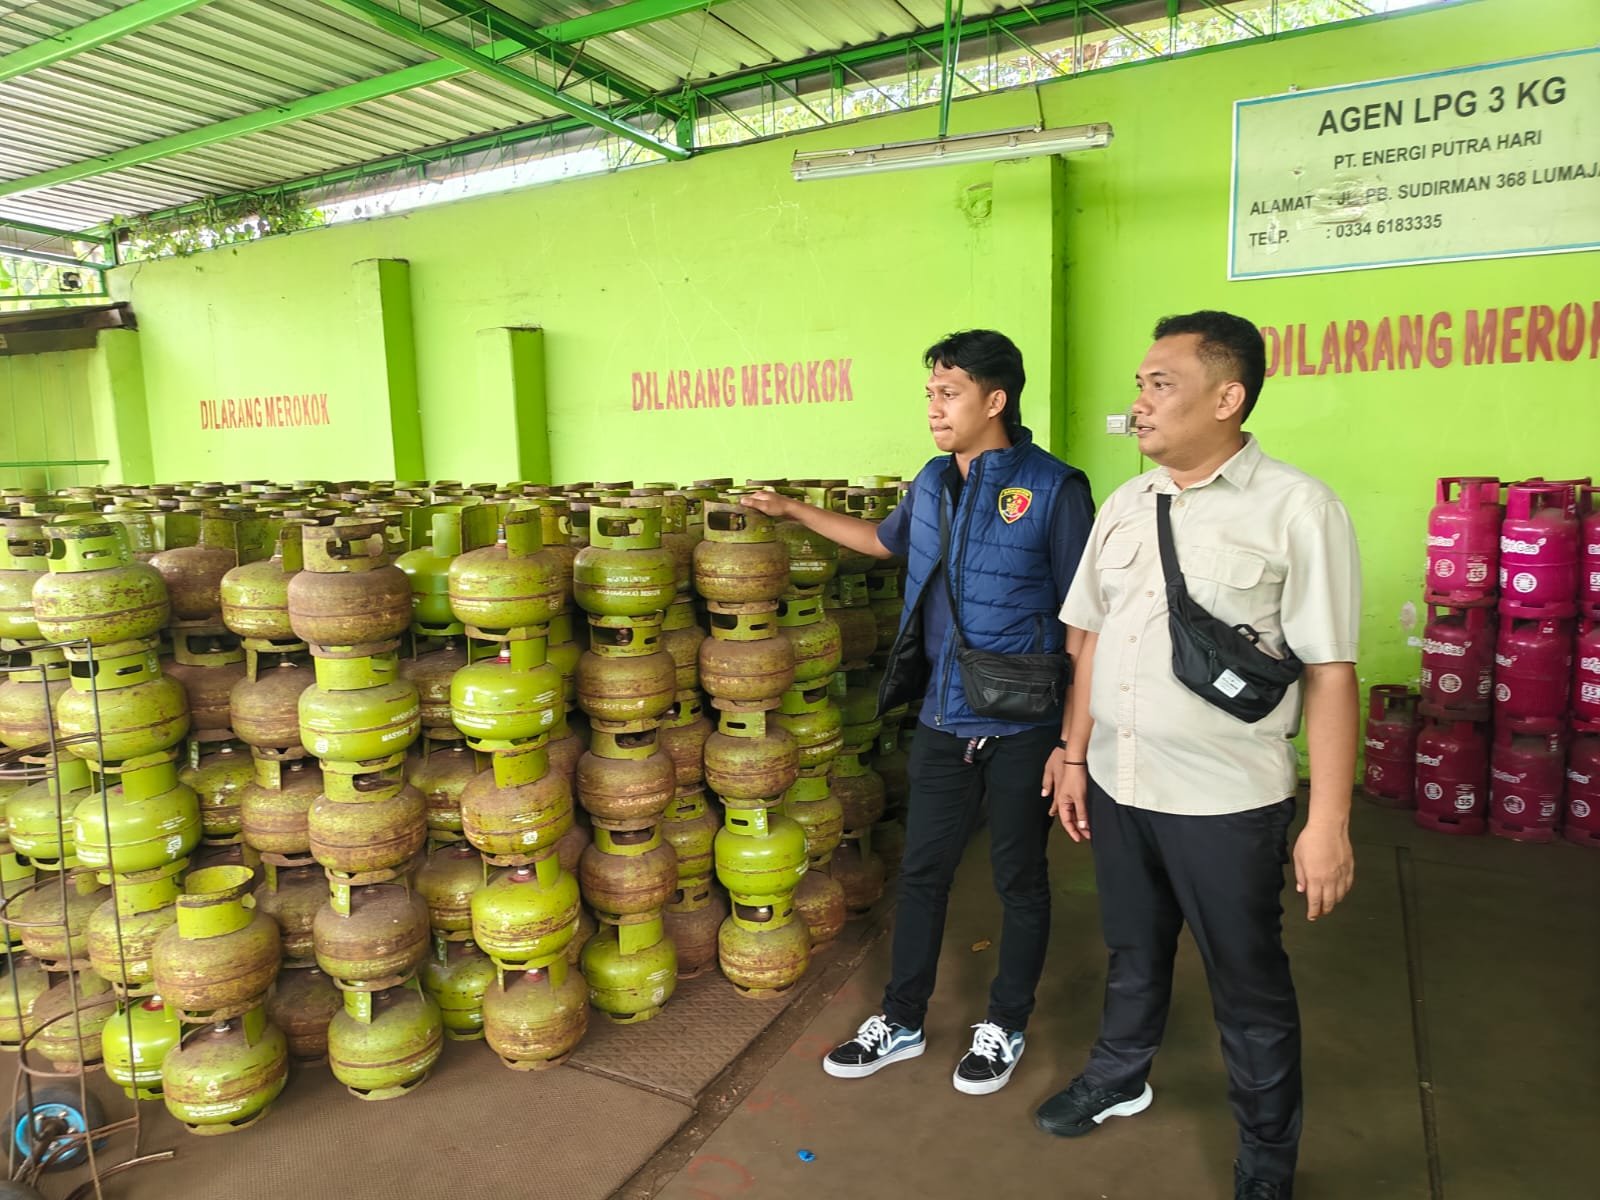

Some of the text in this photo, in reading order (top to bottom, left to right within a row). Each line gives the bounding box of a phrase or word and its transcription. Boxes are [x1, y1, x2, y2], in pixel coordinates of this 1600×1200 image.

[1318, 76, 1566, 136] AGEN LPG 3 KG
[1334, 129, 1542, 170] PT. ENERGI PUTRA HARI
[1250, 195, 1314, 215] ALAMAT
[1398, 175, 1491, 200] SUDIRMAN
[1496, 171, 1526, 189] 368
[1532, 162, 1600, 184] LUMAJ
[1336, 221, 1371, 238] 0334
[1376, 214, 1443, 235] 6183335
[1261, 311, 1452, 378] DILARANG
[632, 358, 854, 411] DILARANG MEROKOK
[200, 393, 330, 430] DILARANG MEROKOK
